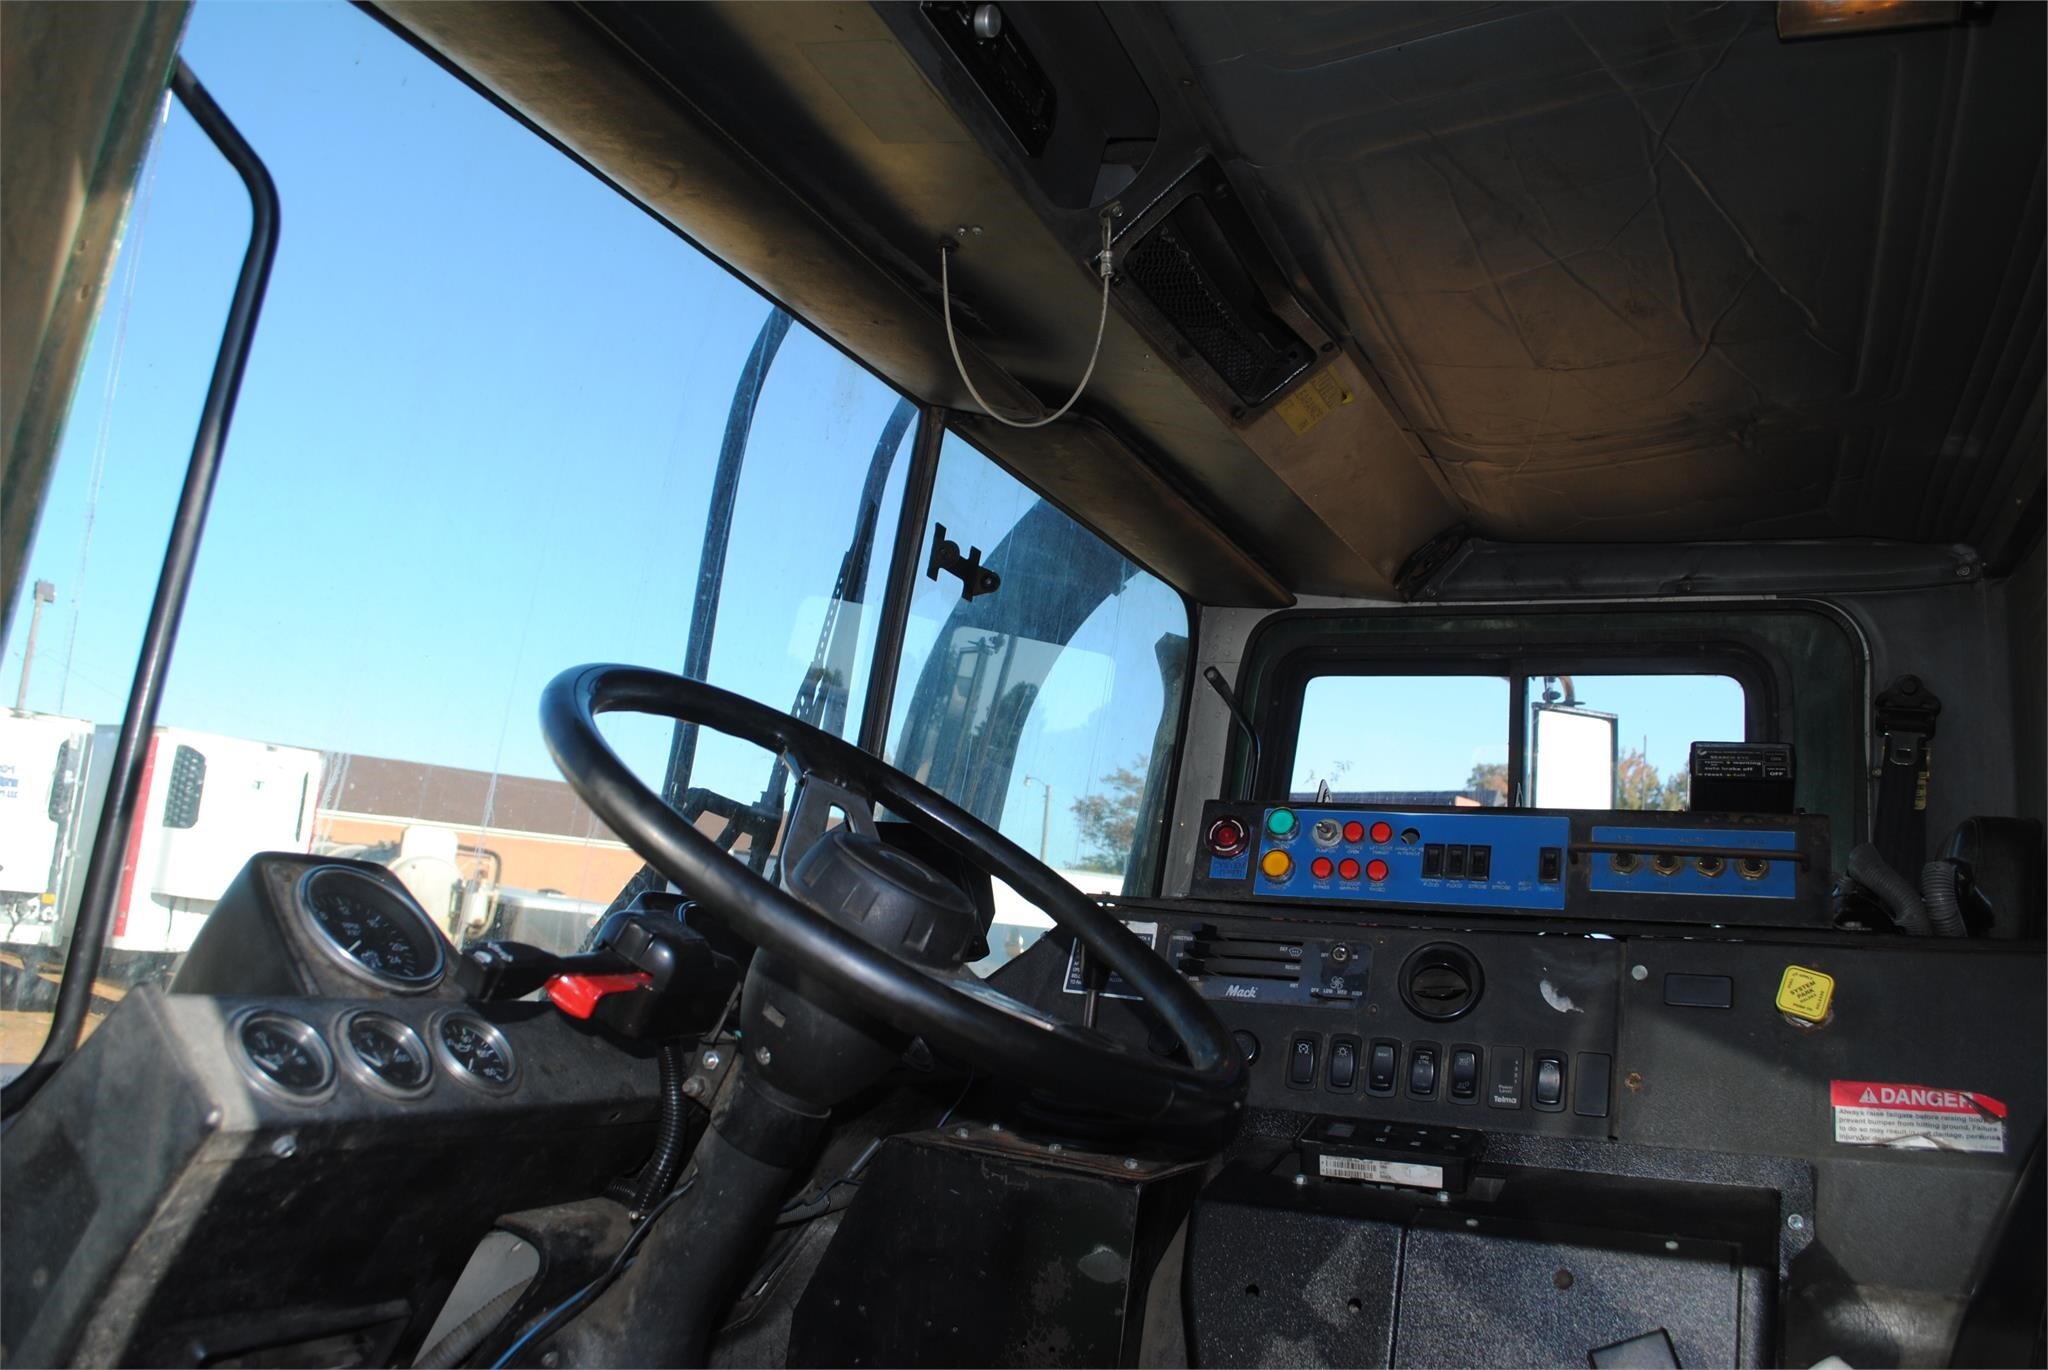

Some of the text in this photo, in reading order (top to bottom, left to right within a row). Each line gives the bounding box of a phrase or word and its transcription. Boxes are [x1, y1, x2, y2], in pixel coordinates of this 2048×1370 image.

[1225, 985, 1257, 999] Mack
[1790, 980, 1816, 996] SYSTEM
[1493, 1095, 1517, 1104] Telma
